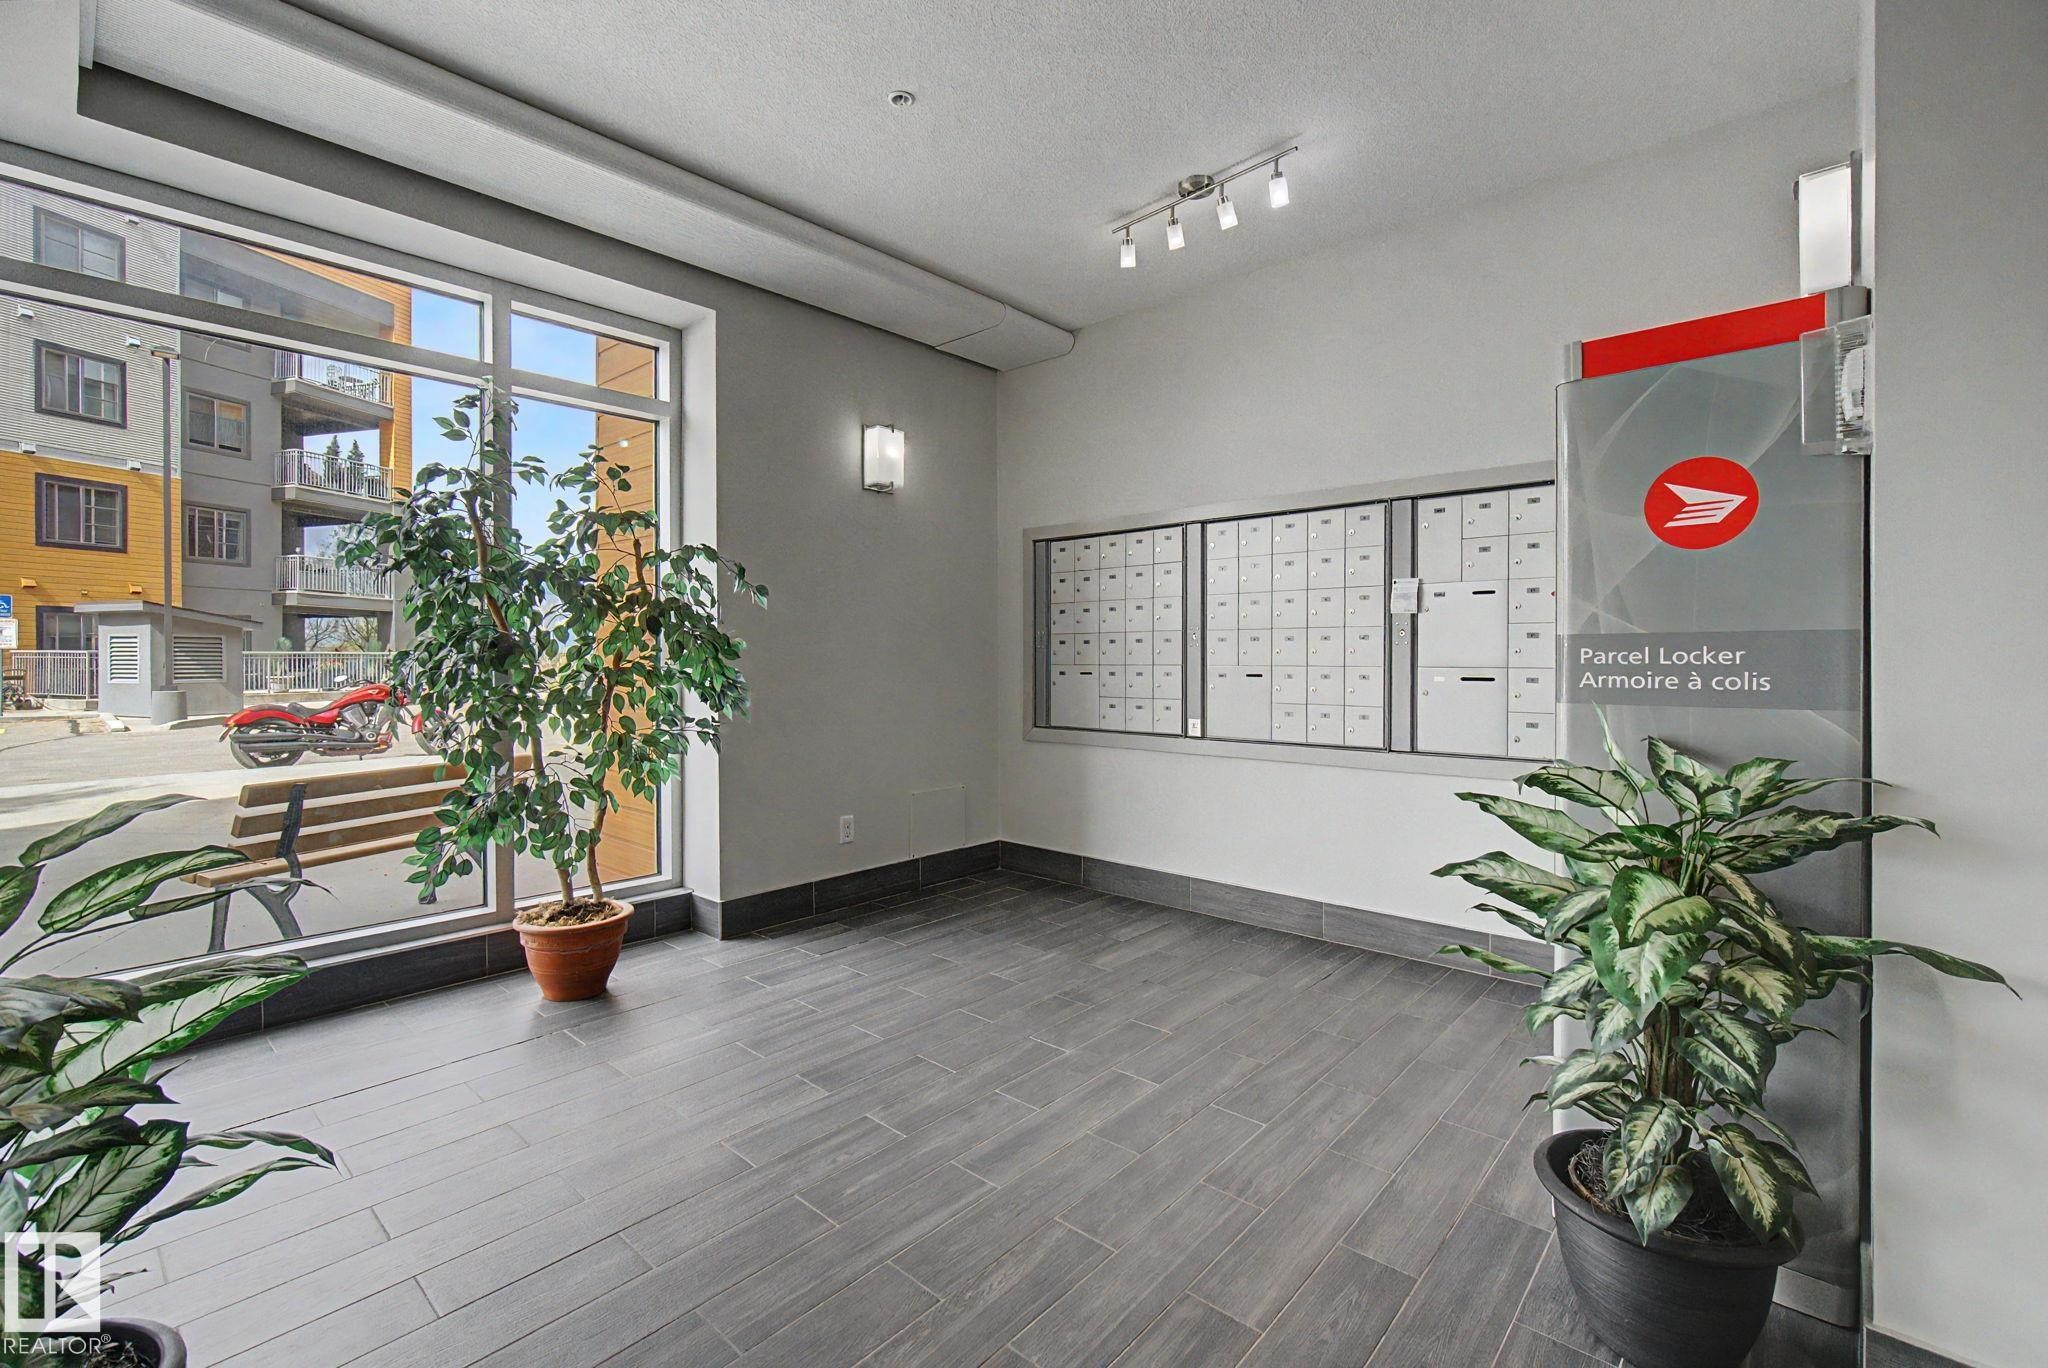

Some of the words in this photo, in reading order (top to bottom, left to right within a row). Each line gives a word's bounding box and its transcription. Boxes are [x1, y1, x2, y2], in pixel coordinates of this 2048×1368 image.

[1580, 646, 1649, 665] Parcel
[1659, 645, 1746, 665] Locker
[1578, 671, 1679, 690] Armoire
[1687, 671, 1702, 690] à
[1711, 671, 1771, 691] colis
